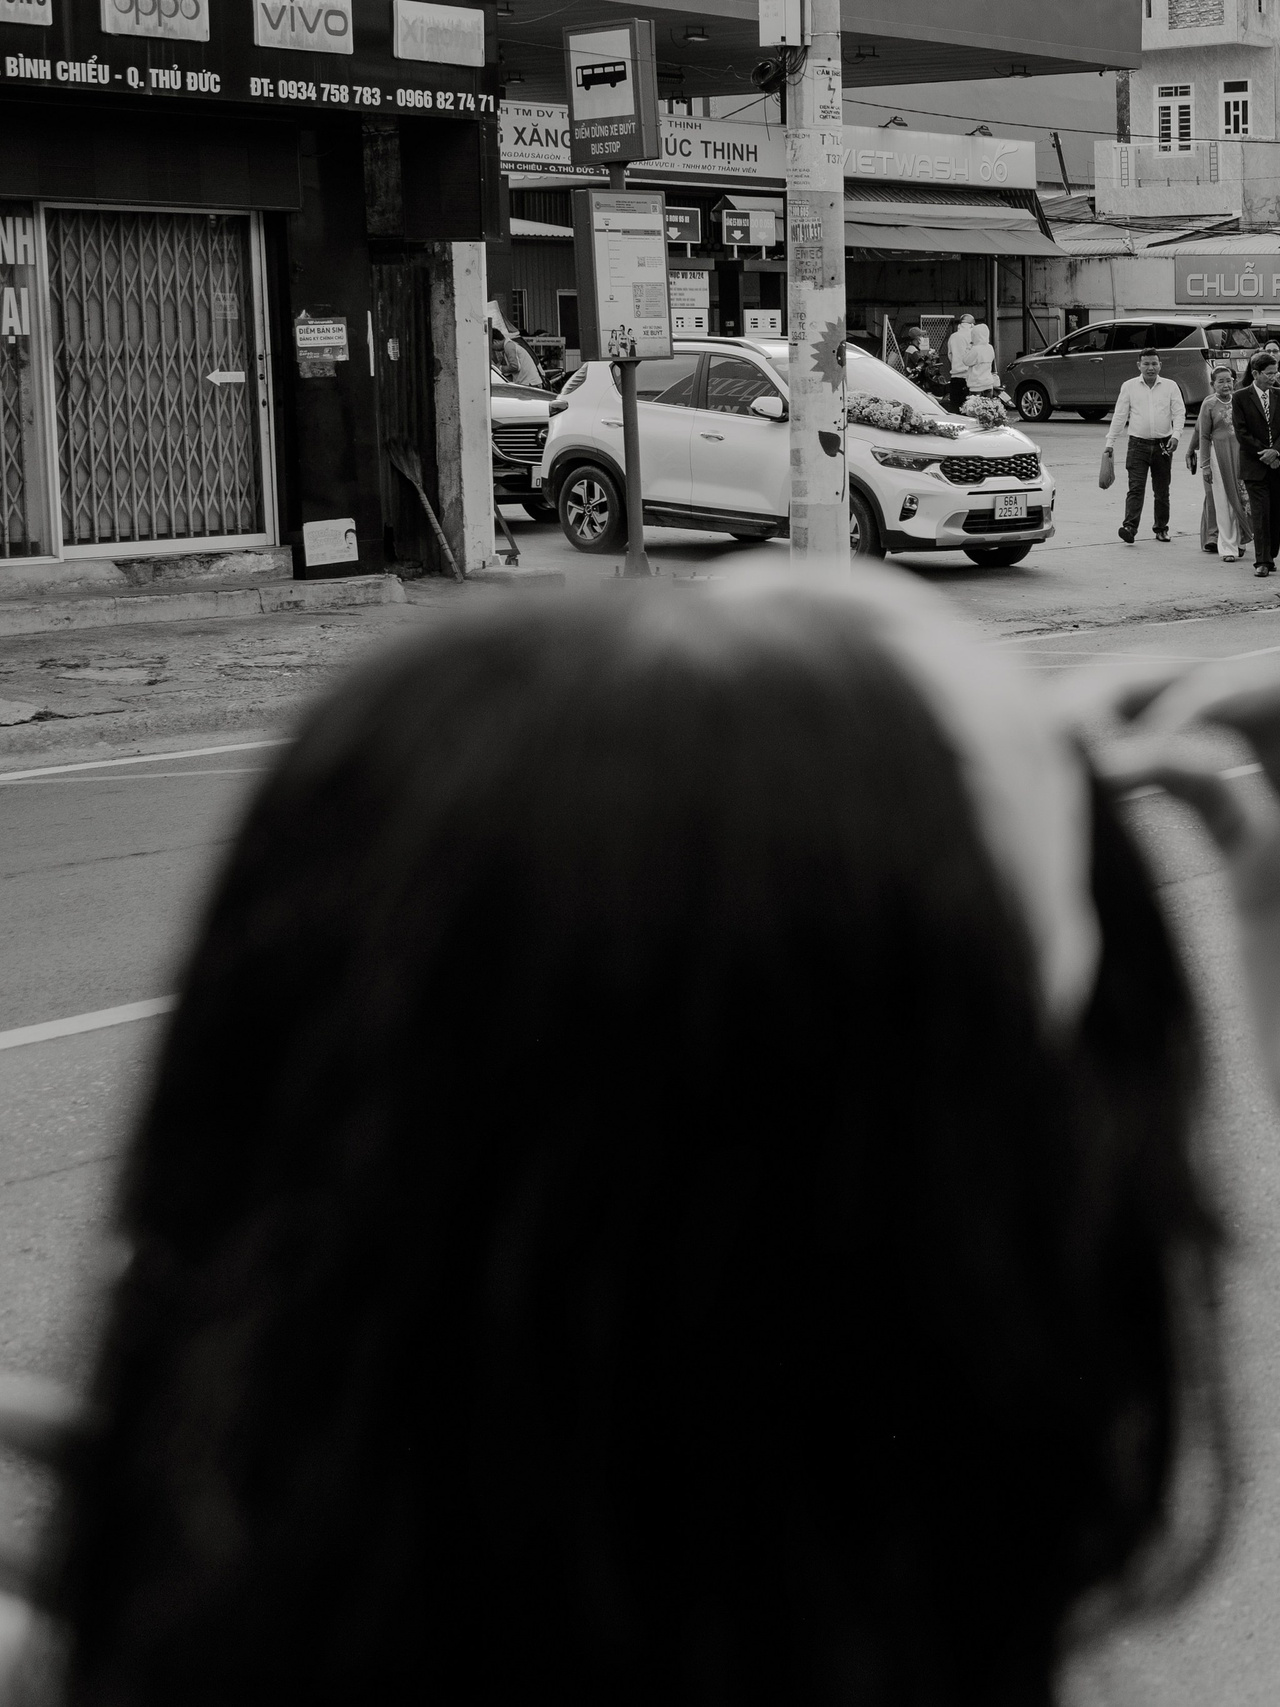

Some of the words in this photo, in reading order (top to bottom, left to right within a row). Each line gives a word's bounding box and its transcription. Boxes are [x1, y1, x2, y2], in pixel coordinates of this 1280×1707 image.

[261, 0, 349, 36] vivo
[6, 53, 51, 80] BÌNH
[56, 55, 110, 84] CHIỂU
[127, 67, 145, 88] Q.
[149, 64, 182, 90] THỦ
[186, 69, 221, 93] ĐỨC
[250, 77, 274, 98] ĐT:
[278, 79, 317, 101] 0934
[320, 83, 349, 104] 758
[352, 86, 381, 106] 783
[396, 88, 433, 109] 0966
[436, 91, 454, 110] 82
[457, 93, 475, 112] 74
[478, 94, 495, 112] 71
[514, 108, 532, 117] TM
[537, 110, 554, 118] DV
[668, 120, 702, 130] THỊNH
[575, 122, 591, 139] ĐIỂM
[591, 123, 609, 138] DÙNG
[609, 124, 619, 136] XE
[619, 120, 636, 135] BUÝT
[591, 143, 605, 155] BUS
[605, 141, 621, 154] STOP
[662, 133, 692, 157] ÚC
[700, 140, 758, 164] THỊNH
[500, 161, 515, 170] ÌNH
[1186, 261, 1265, 297] CHUỖI
[331, 326, 344, 334] SIM
[1004, 496, 1018, 506] 66A
[998, 506, 1023, 518] 225.21
